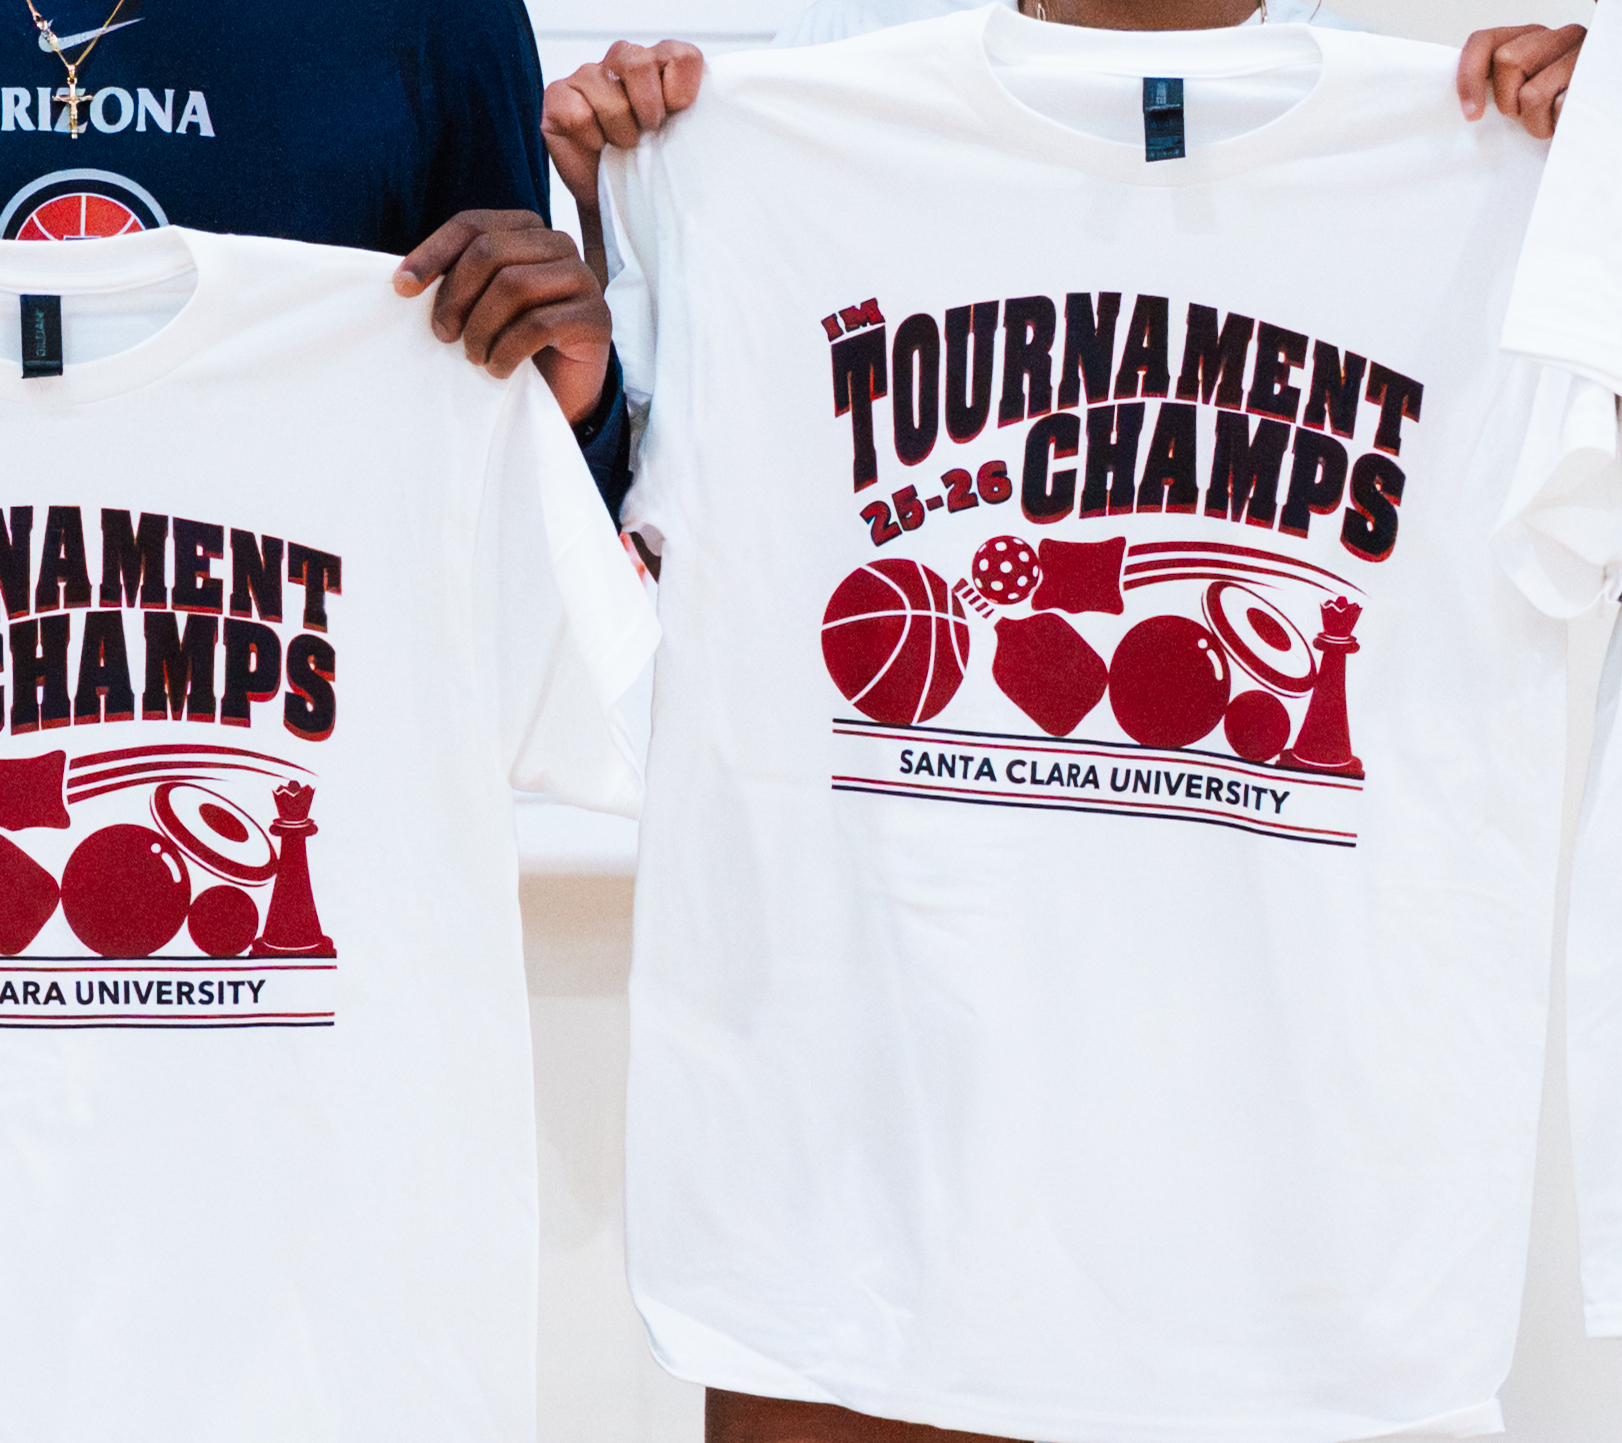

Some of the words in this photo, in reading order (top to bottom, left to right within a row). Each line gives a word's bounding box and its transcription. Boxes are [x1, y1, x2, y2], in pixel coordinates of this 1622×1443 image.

[820, 298, 886, 342] IM
[831, 291, 1424, 494] TOURNAMENT
[859, 460, 1012, 547] 25-26
[1021, 401, 1405, 563] CHAMPS
[899, 749, 997, 782] SANTA
[1006, 759, 1100, 790] CLARA
[1110, 767, 1290, 814] UNIVERSITY
[75, 979, 266, 1006] UNIVERSITY
